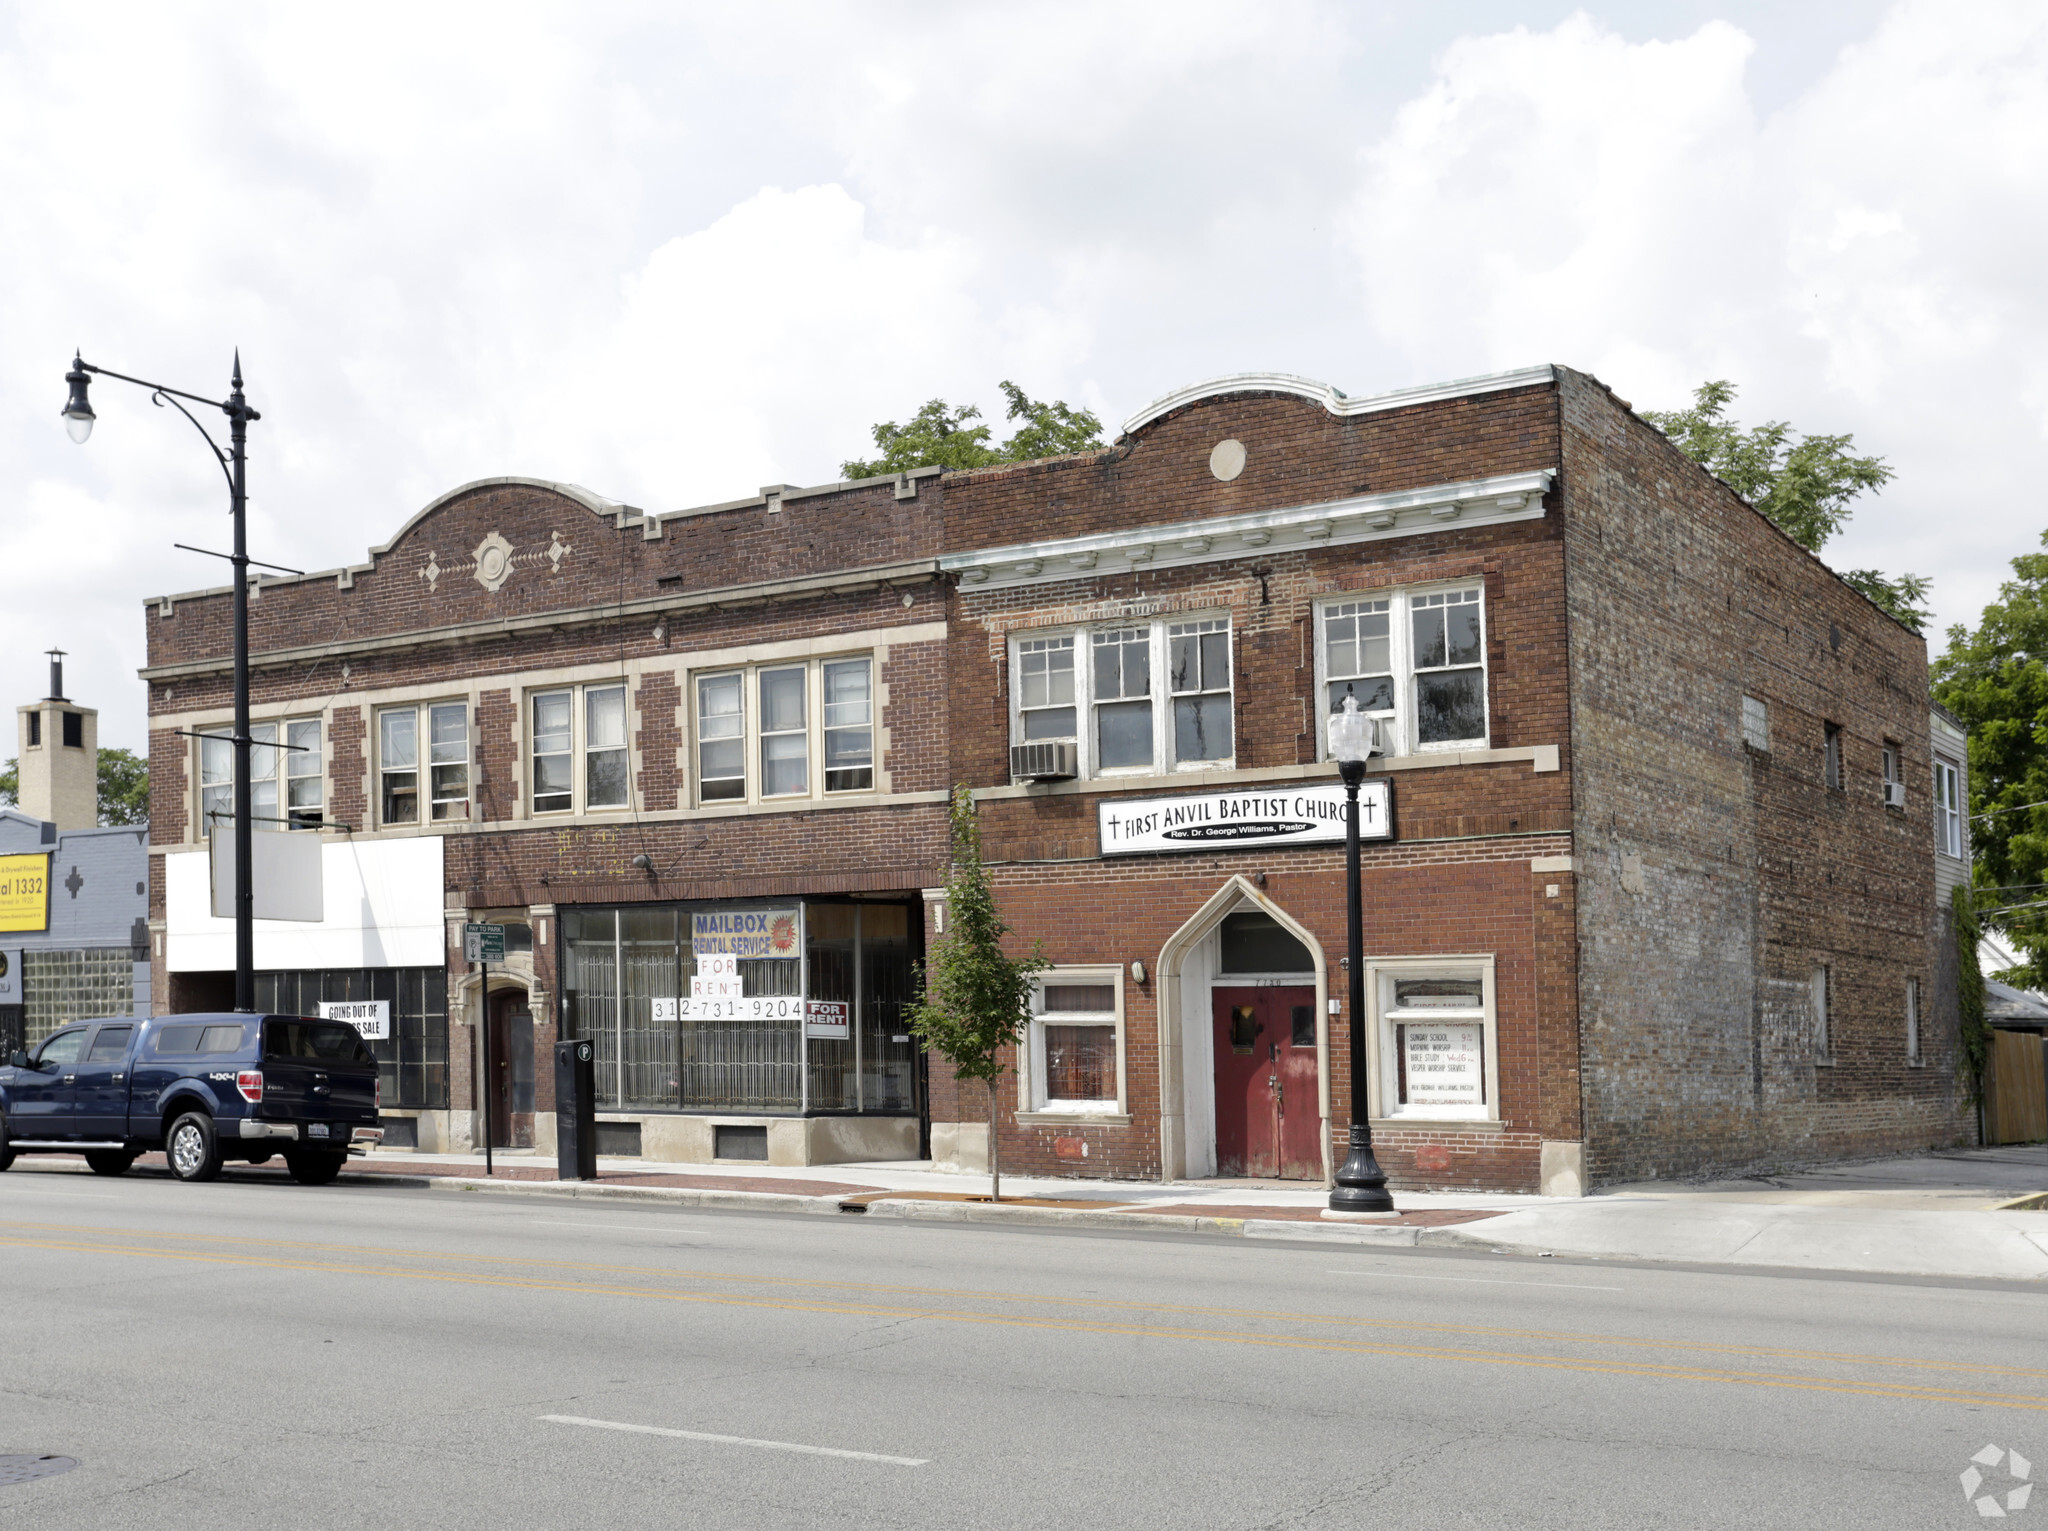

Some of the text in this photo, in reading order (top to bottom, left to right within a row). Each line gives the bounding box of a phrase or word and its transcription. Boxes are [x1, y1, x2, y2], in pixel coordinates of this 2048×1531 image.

[1126, 798, 1347, 839] FIRST ANVIL BAPTIST CHURC
[1206, 828, 1236, 836] George
[1279, 823, 1306, 832] Pastor
[16, 878, 42, 894] 1332
[696, 914, 768, 934] MAILBOX
[694, 936, 770, 955] RENTAL SERVICE
[702, 960, 734, 973] FOR
[694, 982, 740, 995] RENT
[329, 1004, 377, 1019] GOING OUT OF
[811, 1004, 840, 1014] FOR
[807, 1014, 844, 1024] RENT
[363, 1022, 380, 1034] SALE
[1410, 1034, 1428, 1042] SUNDAY
[1430, 1034, 1448, 1042] SCHOOL
[1410, 1054, 1422, 1062] BIBLE
[1425, 1054, 1440, 1062] STUDY
[1428, 1064, 1445, 1072] WORSHIP
[1448, 1064, 1466, 1072] SERVICE
